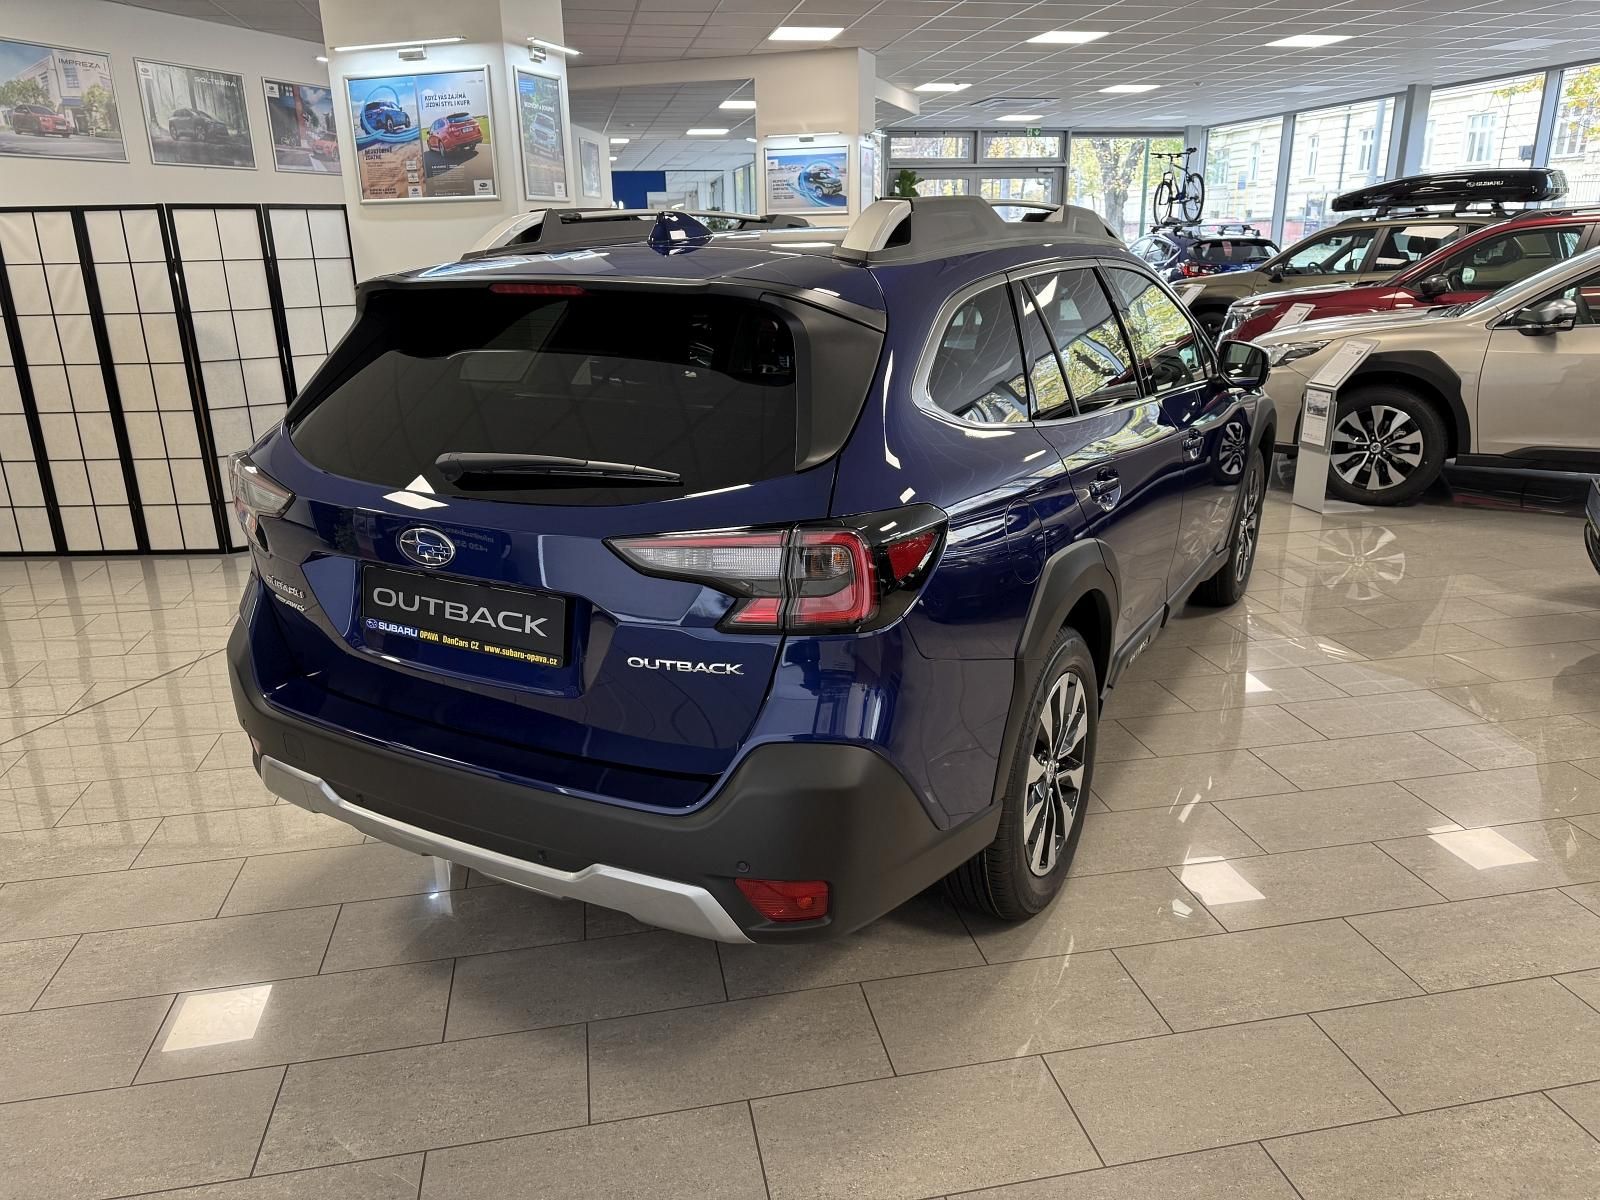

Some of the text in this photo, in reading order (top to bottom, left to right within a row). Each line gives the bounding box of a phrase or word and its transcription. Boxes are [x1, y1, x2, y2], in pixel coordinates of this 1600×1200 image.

[58, 58, 101, 70] IMPREZA
[194, 76, 237, 88] SOLTERRA
[372, 586, 548, 638] OUTBACK
[378, 621, 558, 666] SUBARU OPAVA DanCars CZ www.subaru-opava.cz
[627, 656, 744, 675] OUTBACK
